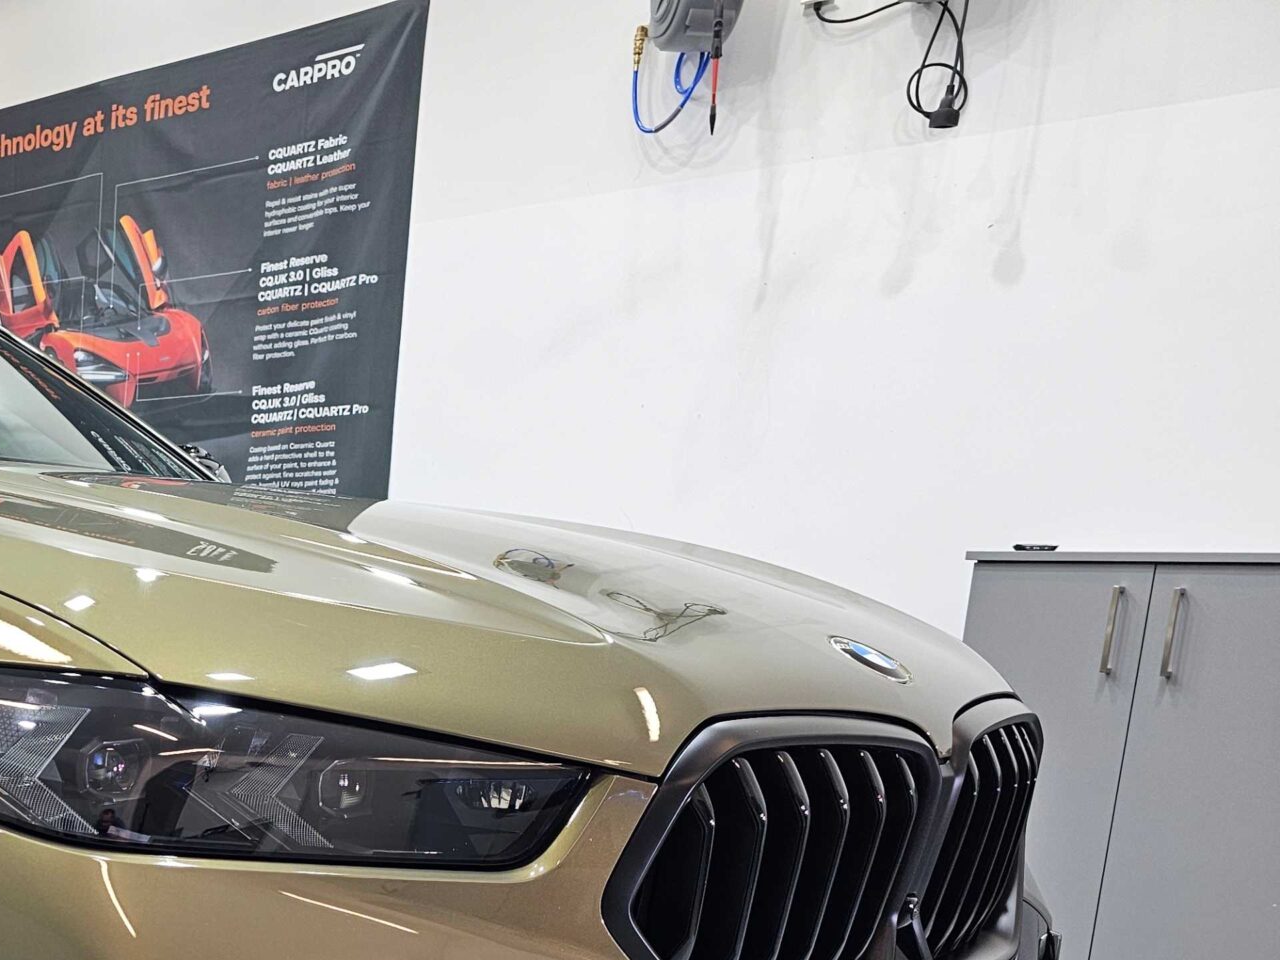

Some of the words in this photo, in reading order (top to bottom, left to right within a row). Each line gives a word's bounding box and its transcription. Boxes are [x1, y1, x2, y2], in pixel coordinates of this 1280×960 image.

[272, 55, 356, 92] CARPRO
[83, 110, 104, 137] at
[111, 103, 138, 130] its
[144, 85, 211, 122] finest
[269, 141, 316, 160] CQUARTZ
[318, 134, 348, 150] Fabric
[268, 156, 315, 175] CQUARTZ
[316, 149, 351, 165] Leather
[261, 260, 288, 273] Finest
[289, 254, 328, 267] Reserve
[312, 267, 338, 279] Gliss
[258, 285, 302, 301] CQUARTZ
[311, 275, 357, 293] CQUARTZ
[359, 274, 378, 284] Pro
[281, 303, 299, 312] fiber
[302, 298, 339, 311] protection
[252, 384, 281, 396] Finest
[283, 380, 315, 394] Reserve
[301, 393, 325, 405] Gliss
[251, 410, 293, 424] CQUARTZ
[299, 405, 350, 418] CQUARTZ
[352, 404, 369, 414] Pro
[295, 423, 336, 435] protection
